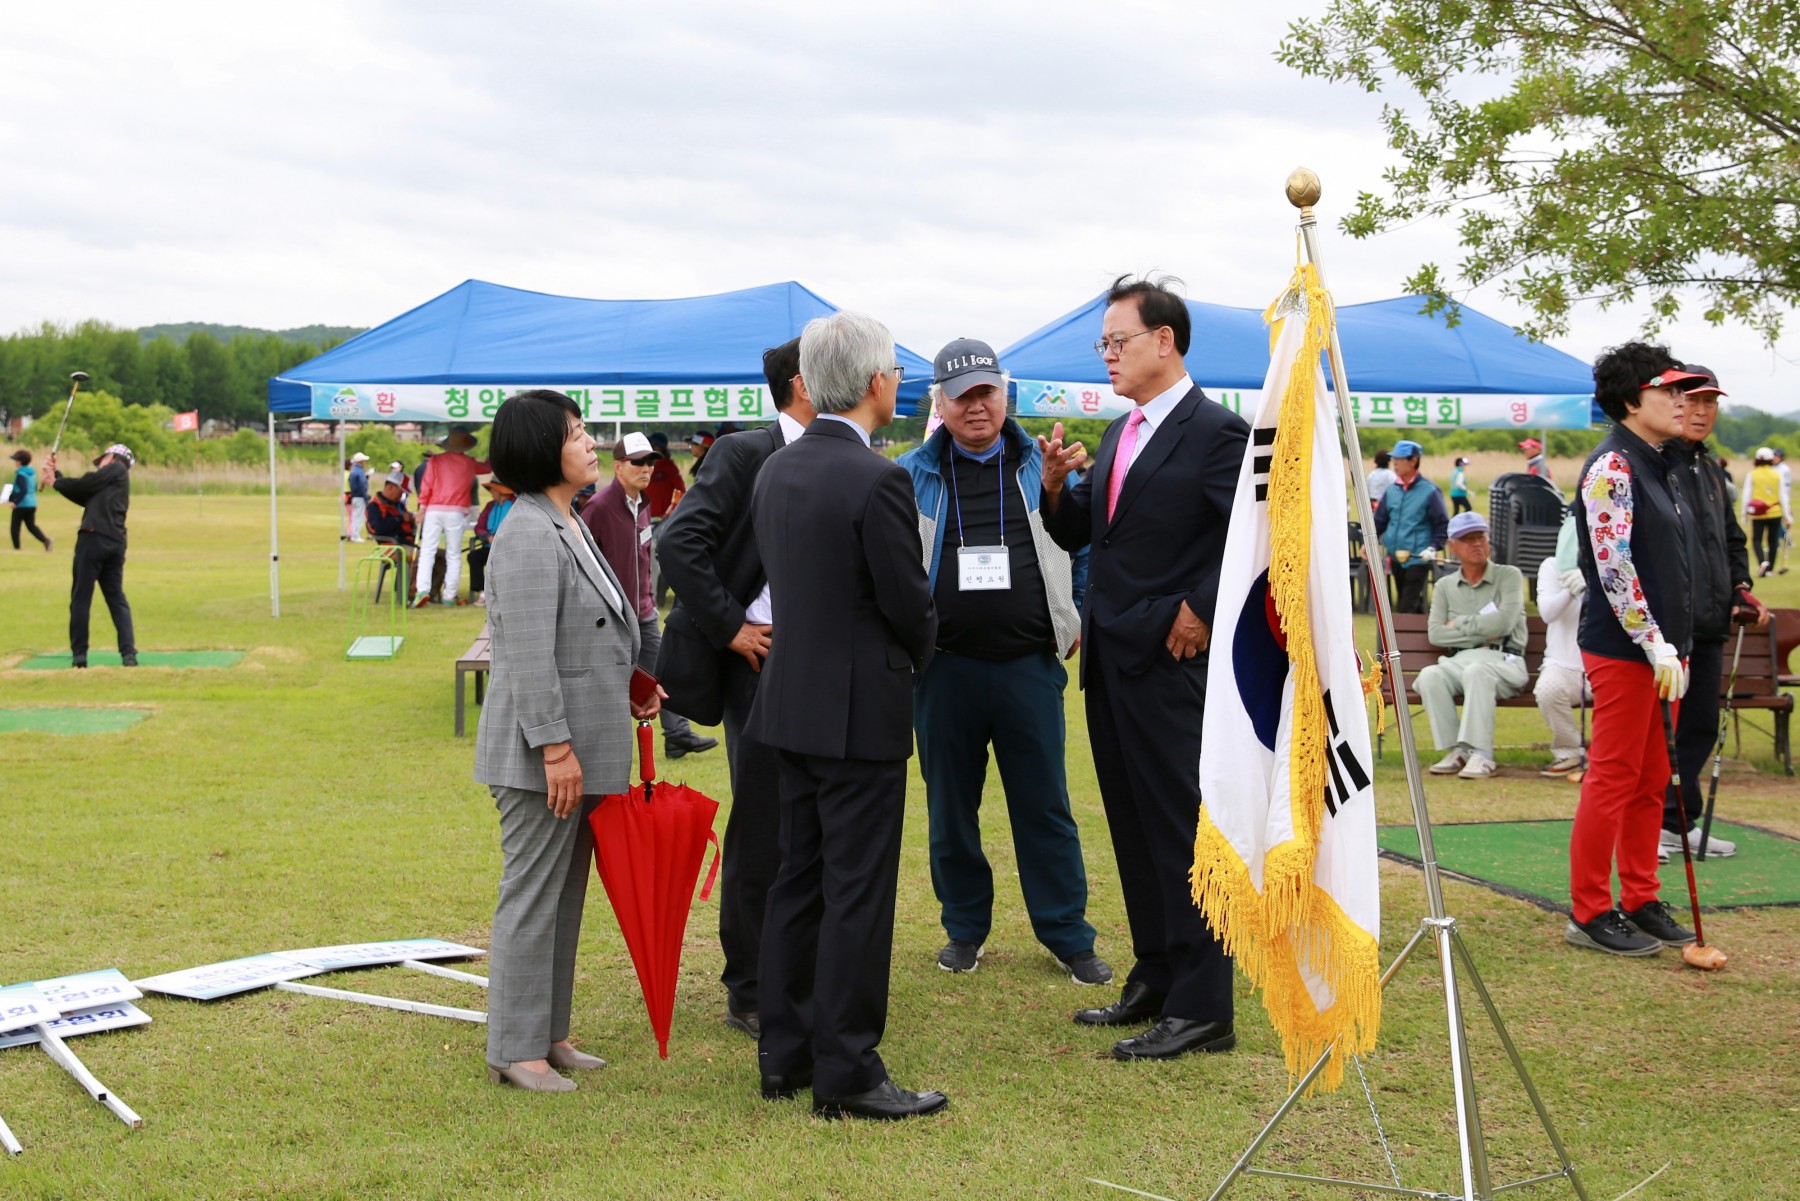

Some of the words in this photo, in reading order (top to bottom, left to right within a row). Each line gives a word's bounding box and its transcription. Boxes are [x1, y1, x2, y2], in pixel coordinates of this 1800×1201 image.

[947, 354, 977, 372] ELLE
[376, 392, 397, 414] 환
[564, 386, 763, 419] 파크골프협회
[1081, 390, 1101, 412] 환
